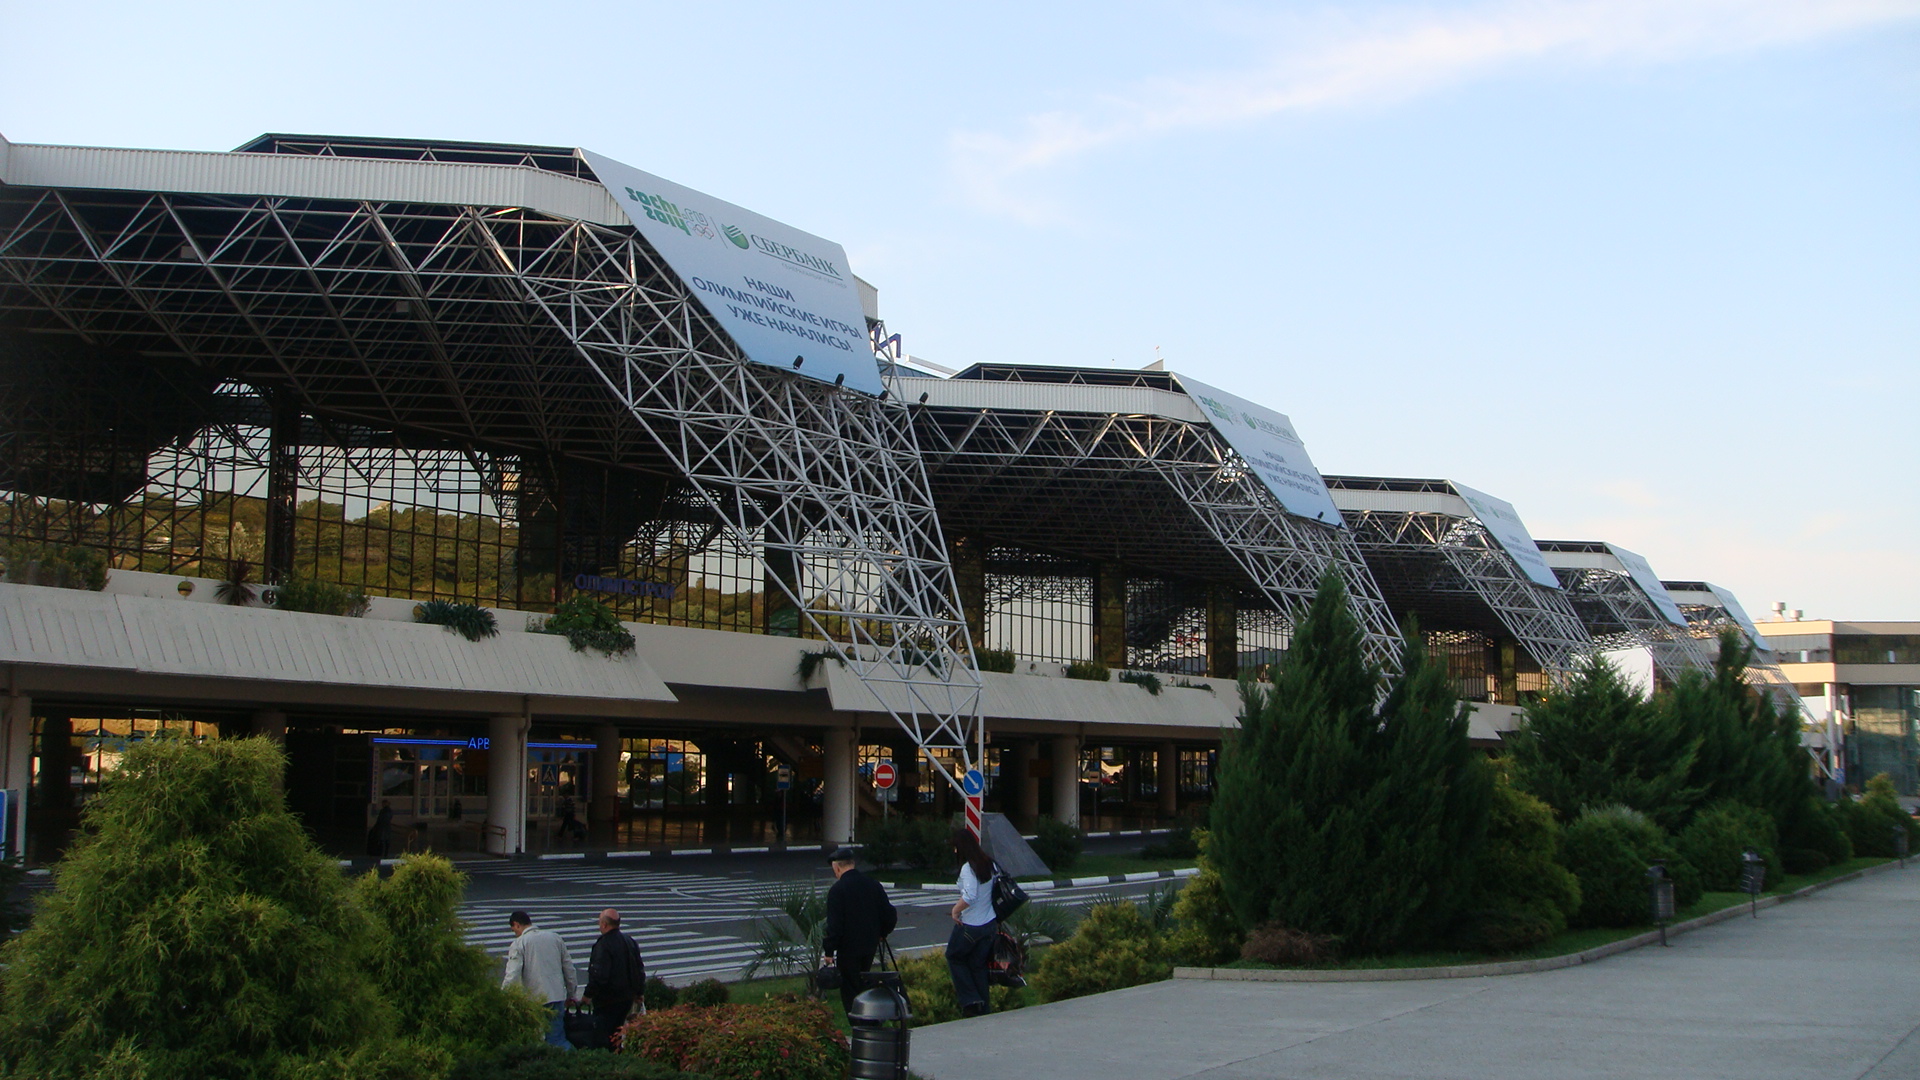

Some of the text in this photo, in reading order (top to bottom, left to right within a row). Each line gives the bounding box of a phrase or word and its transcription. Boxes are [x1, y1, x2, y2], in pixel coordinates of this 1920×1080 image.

[641, 204, 692, 236] 2014
[750, 234, 840, 276] СБЕРБАНК
[692, 276, 863, 340] ОЛИМПИЙСКИЕ ИГРЫ
[743, 275, 796, 303] НАШИ
[726, 303, 854, 353] УЖЕ НАЧАЛИСЬ!
